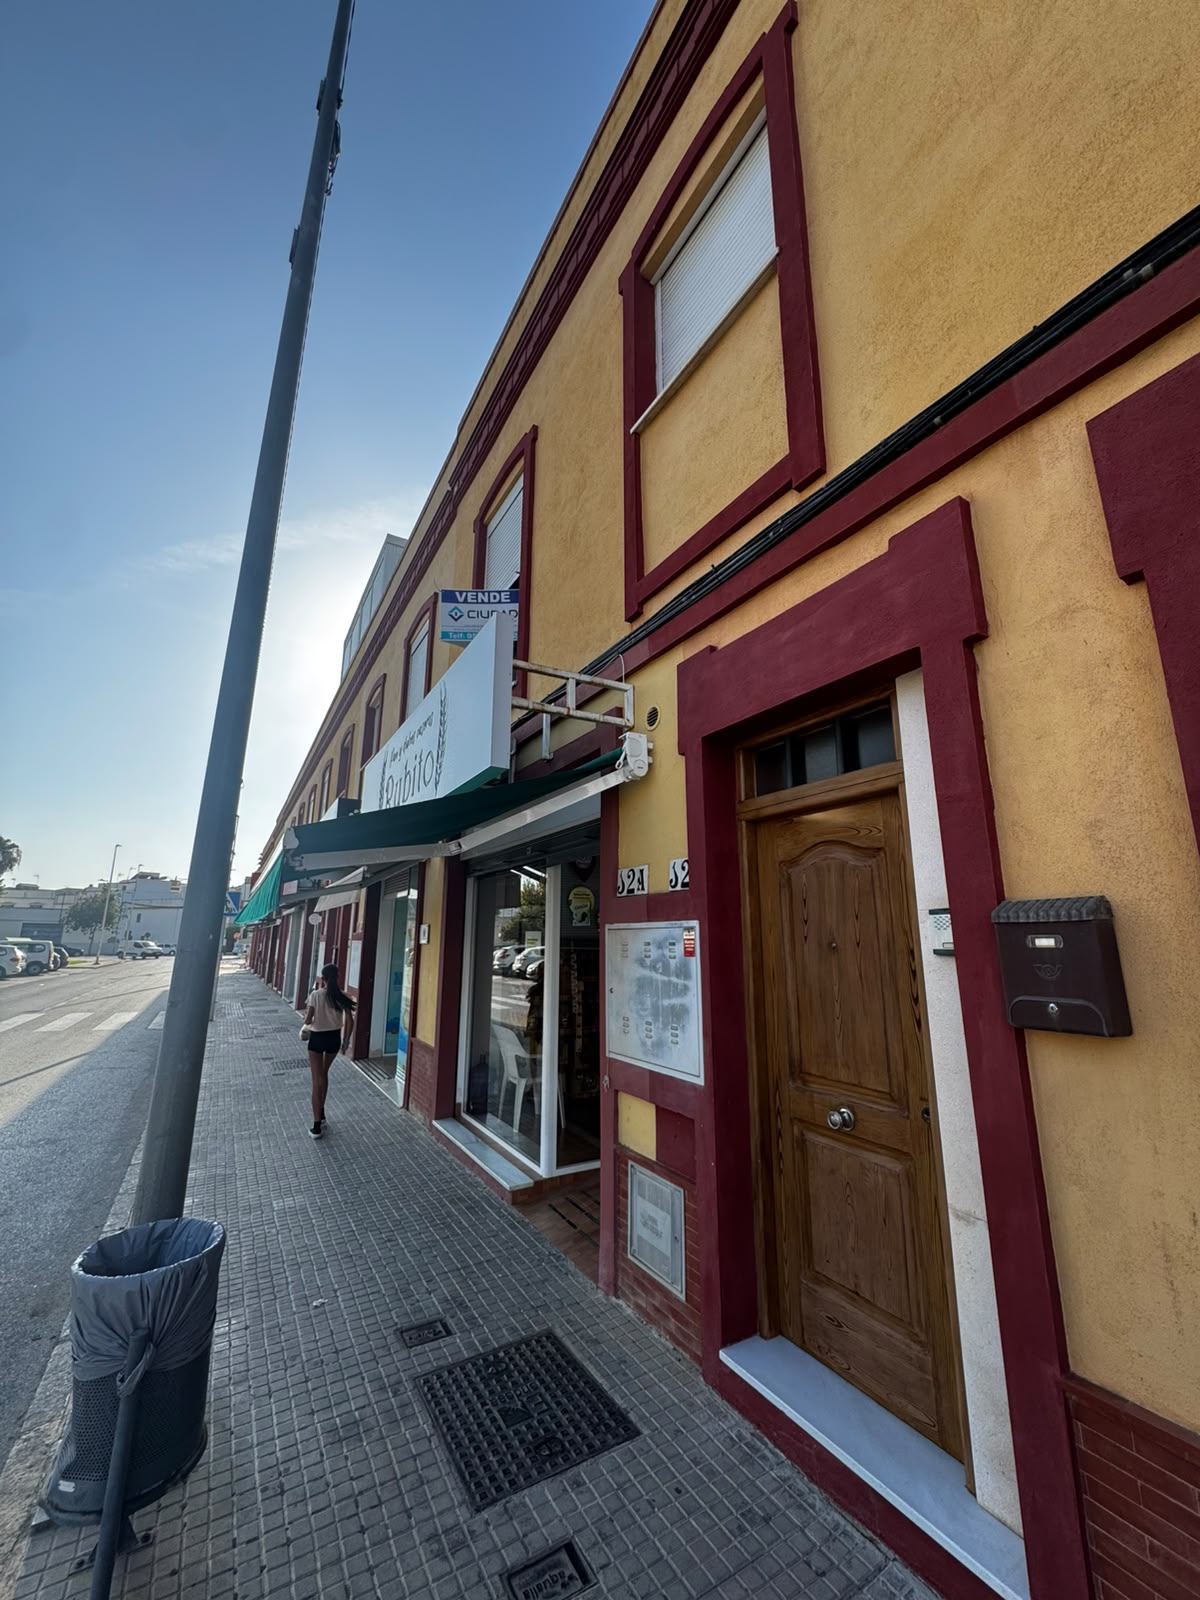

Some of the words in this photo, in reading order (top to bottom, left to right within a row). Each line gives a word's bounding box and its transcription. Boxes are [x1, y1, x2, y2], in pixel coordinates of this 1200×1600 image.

[455, 591, 511, 603] VENDE
[467, 609, 518, 619] CIUD
[385, 749, 435, 809] Rubito
